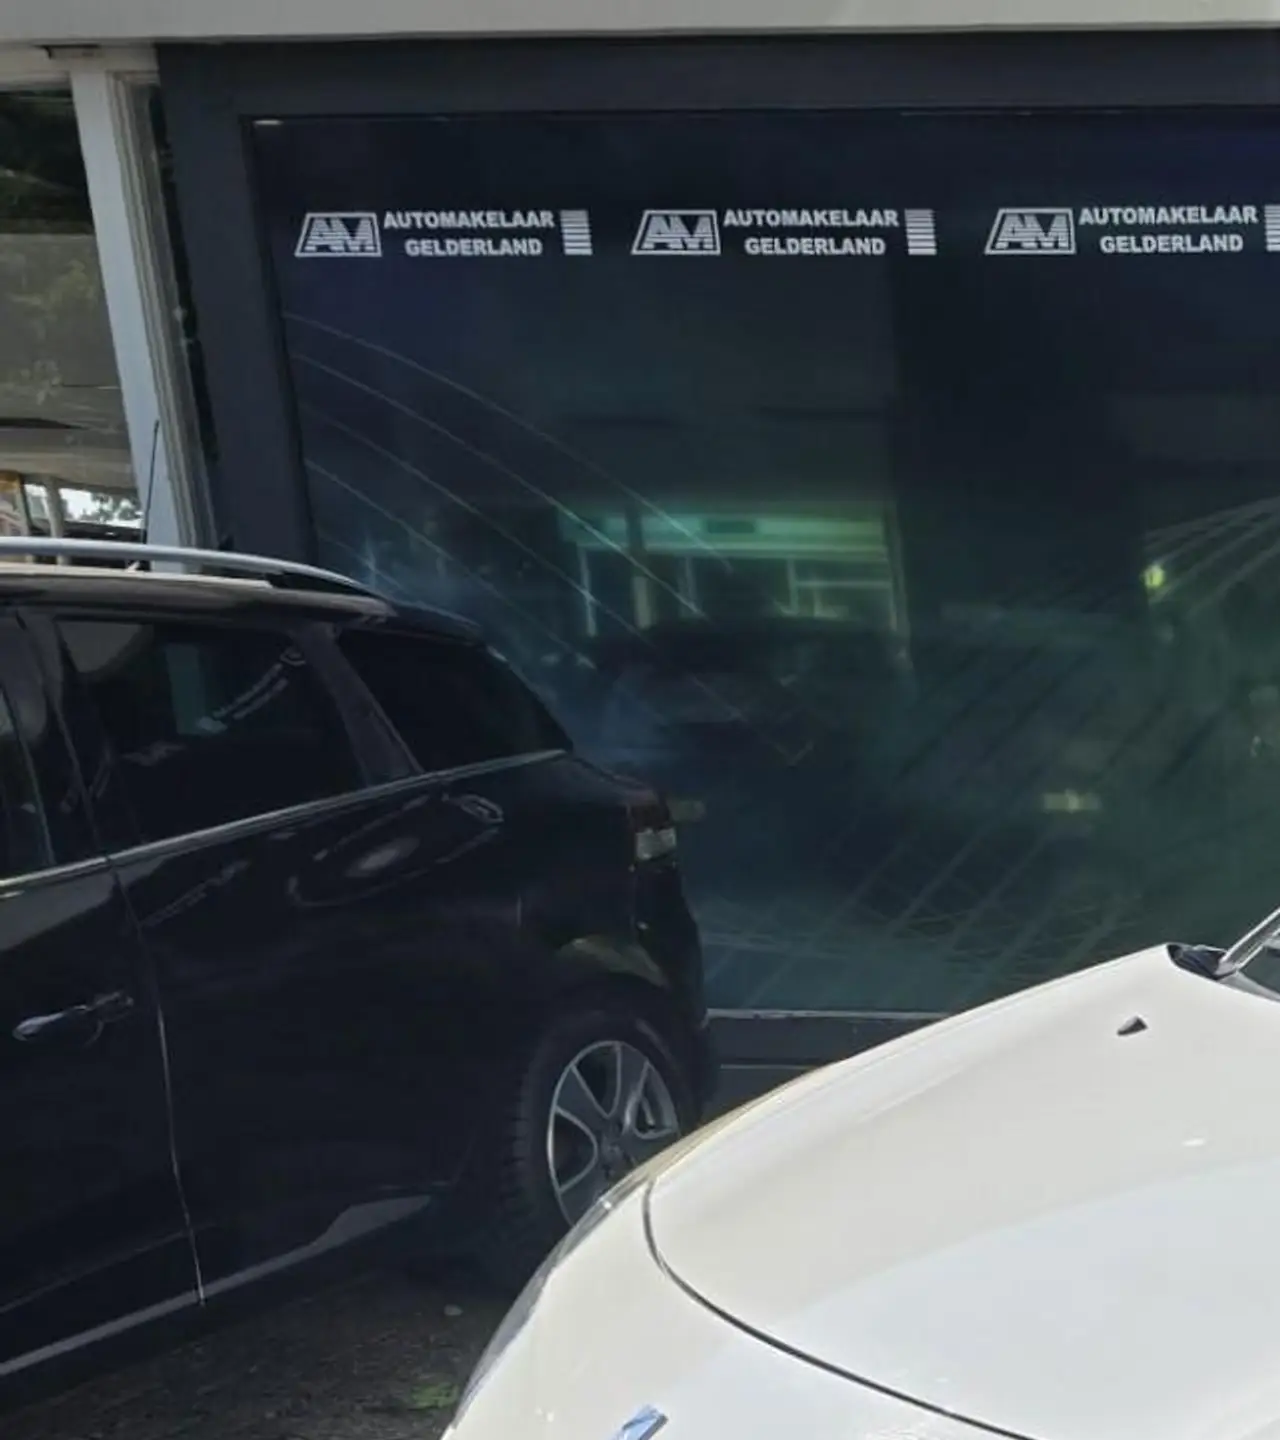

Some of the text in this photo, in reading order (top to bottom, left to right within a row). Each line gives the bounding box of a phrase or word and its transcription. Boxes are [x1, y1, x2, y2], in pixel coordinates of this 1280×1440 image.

[383, 210, 555, 229] AUTOMAKELAAR
[723, 209, 900, 228] AUTOMAKELAAR
[1078, 205, 1259, 226] AUTOMAKELAAR
[303, 216, 376, 253] AM
[640, 214, 715, 250] AM
[995, 212, 1069, 249] AM
[404, 238, 543, 257] GELDERLAND
[744, 237, 886, 256] GELDERLAND
[1099, 233, 1244, 253] GELDERLAND
